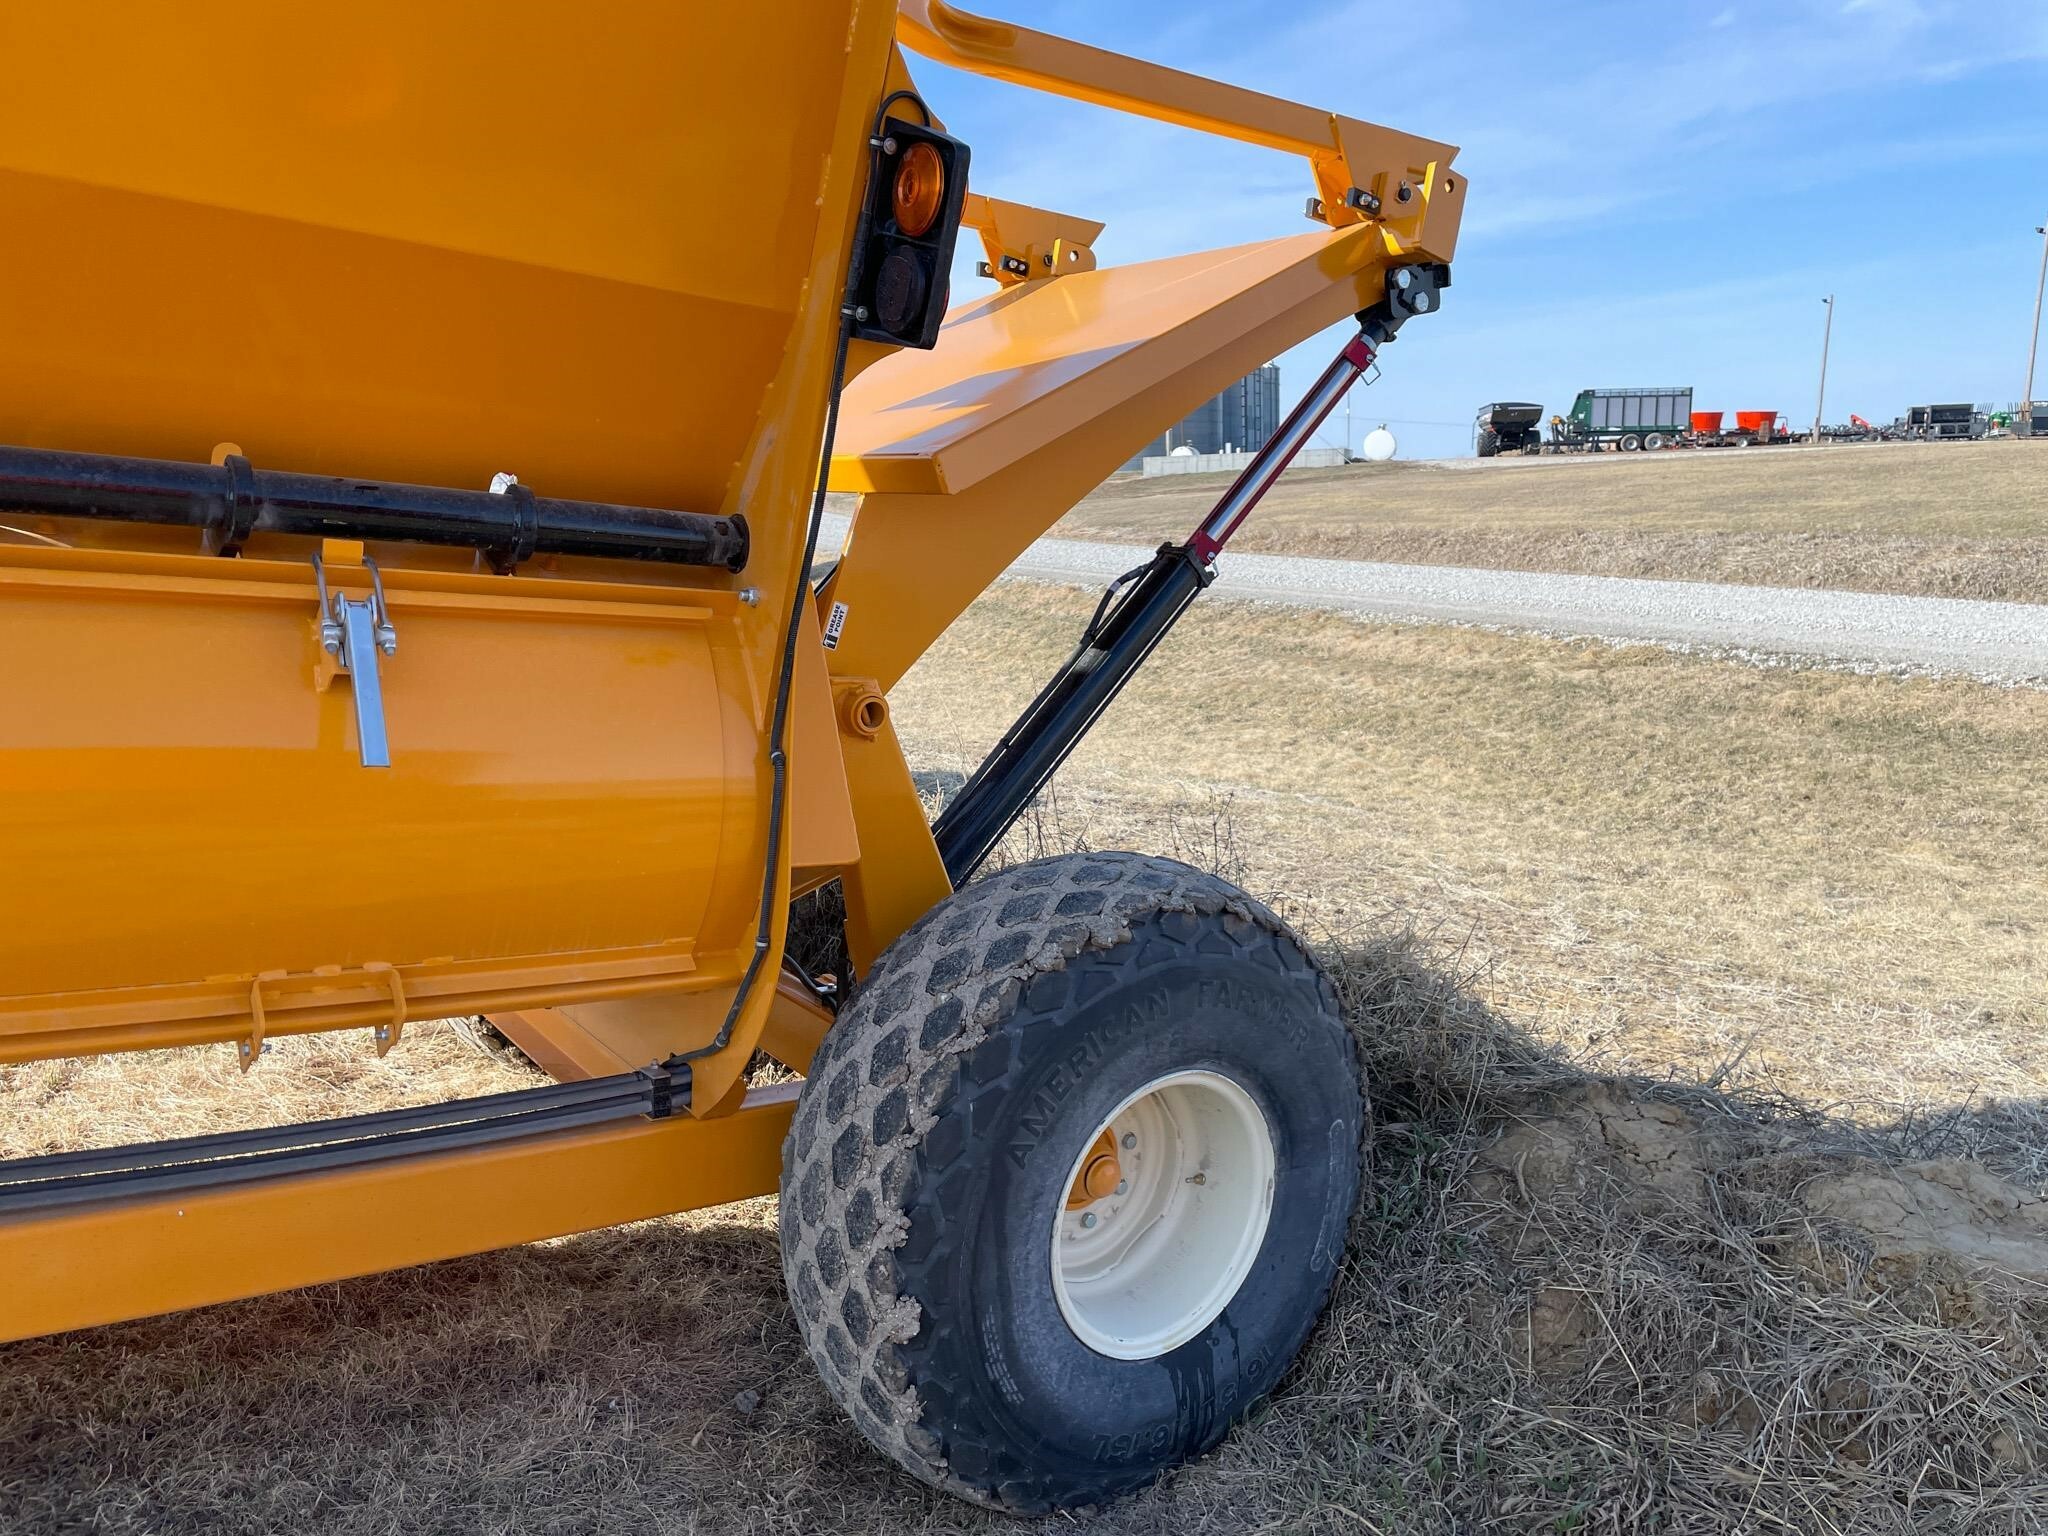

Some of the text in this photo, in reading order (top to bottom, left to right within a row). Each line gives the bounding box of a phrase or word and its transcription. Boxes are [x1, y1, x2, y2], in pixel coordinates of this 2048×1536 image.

[828, 604, 840, 633] GREASE
[834, 609, 845, 632] POINT
[1007, 986, 1171, 1170] AMERICAN
